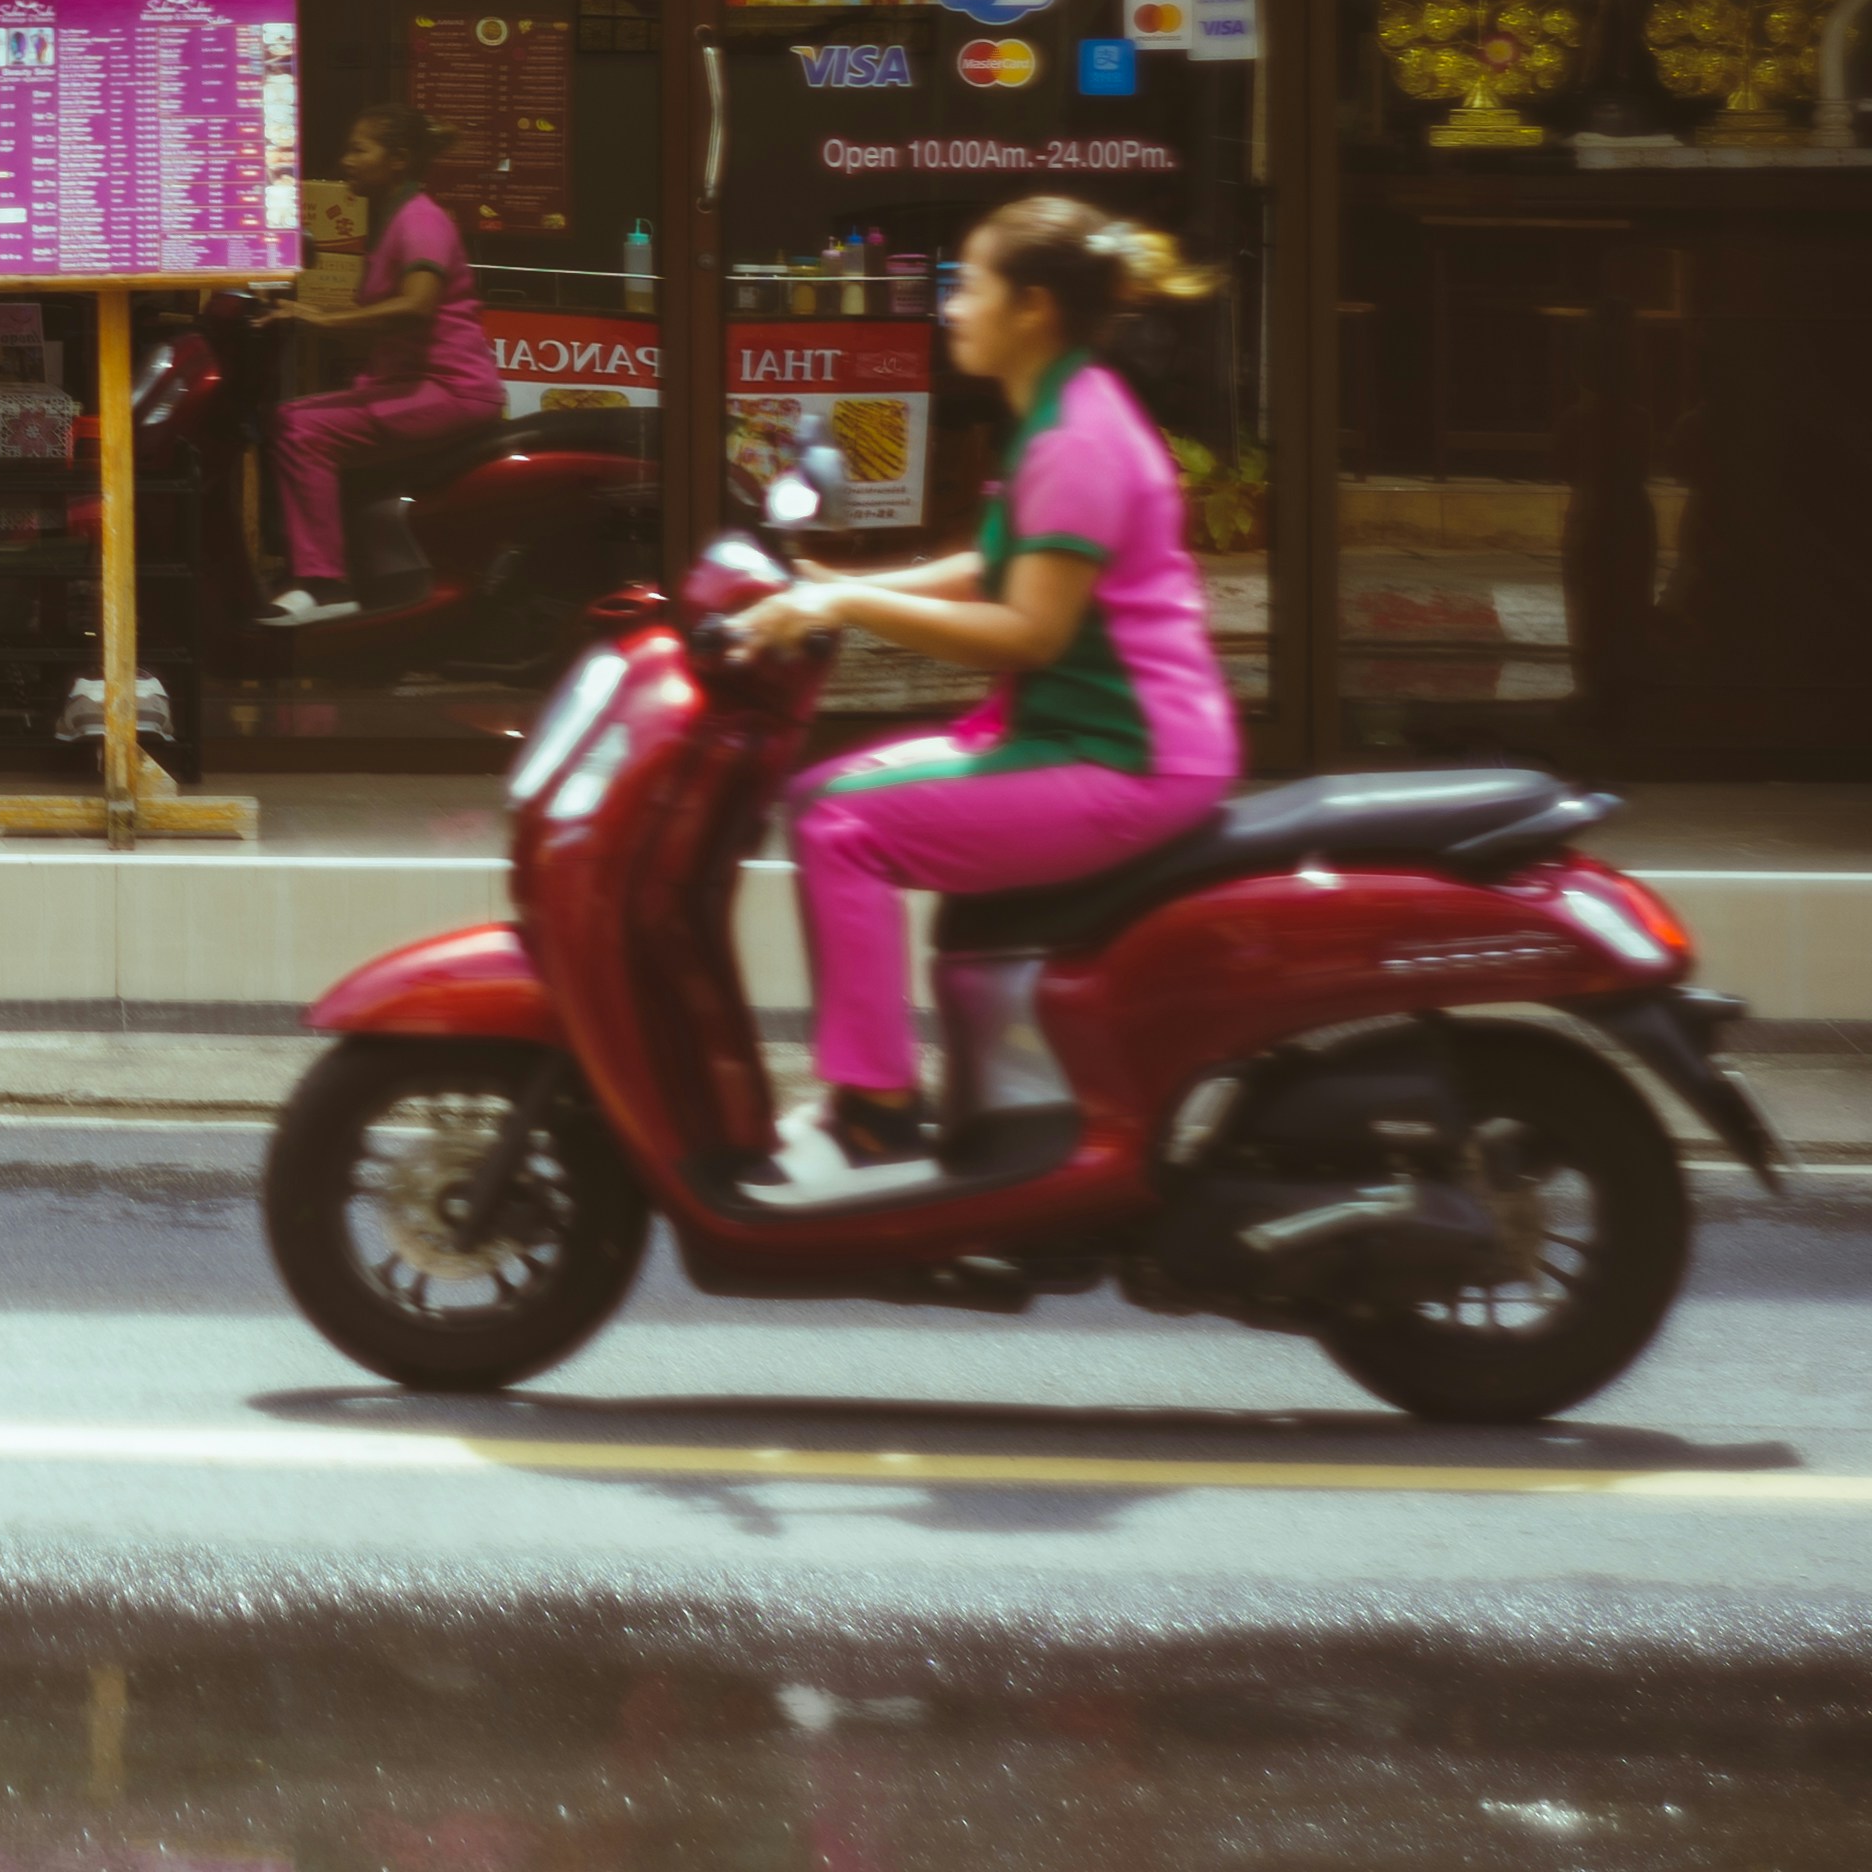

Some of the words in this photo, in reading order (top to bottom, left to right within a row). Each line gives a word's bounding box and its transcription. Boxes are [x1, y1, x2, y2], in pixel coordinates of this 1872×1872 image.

[1198, 20, 1245, 36] VISA
[790, 45, 913, 88] VISA
[823, 138, 896, 175] Open
